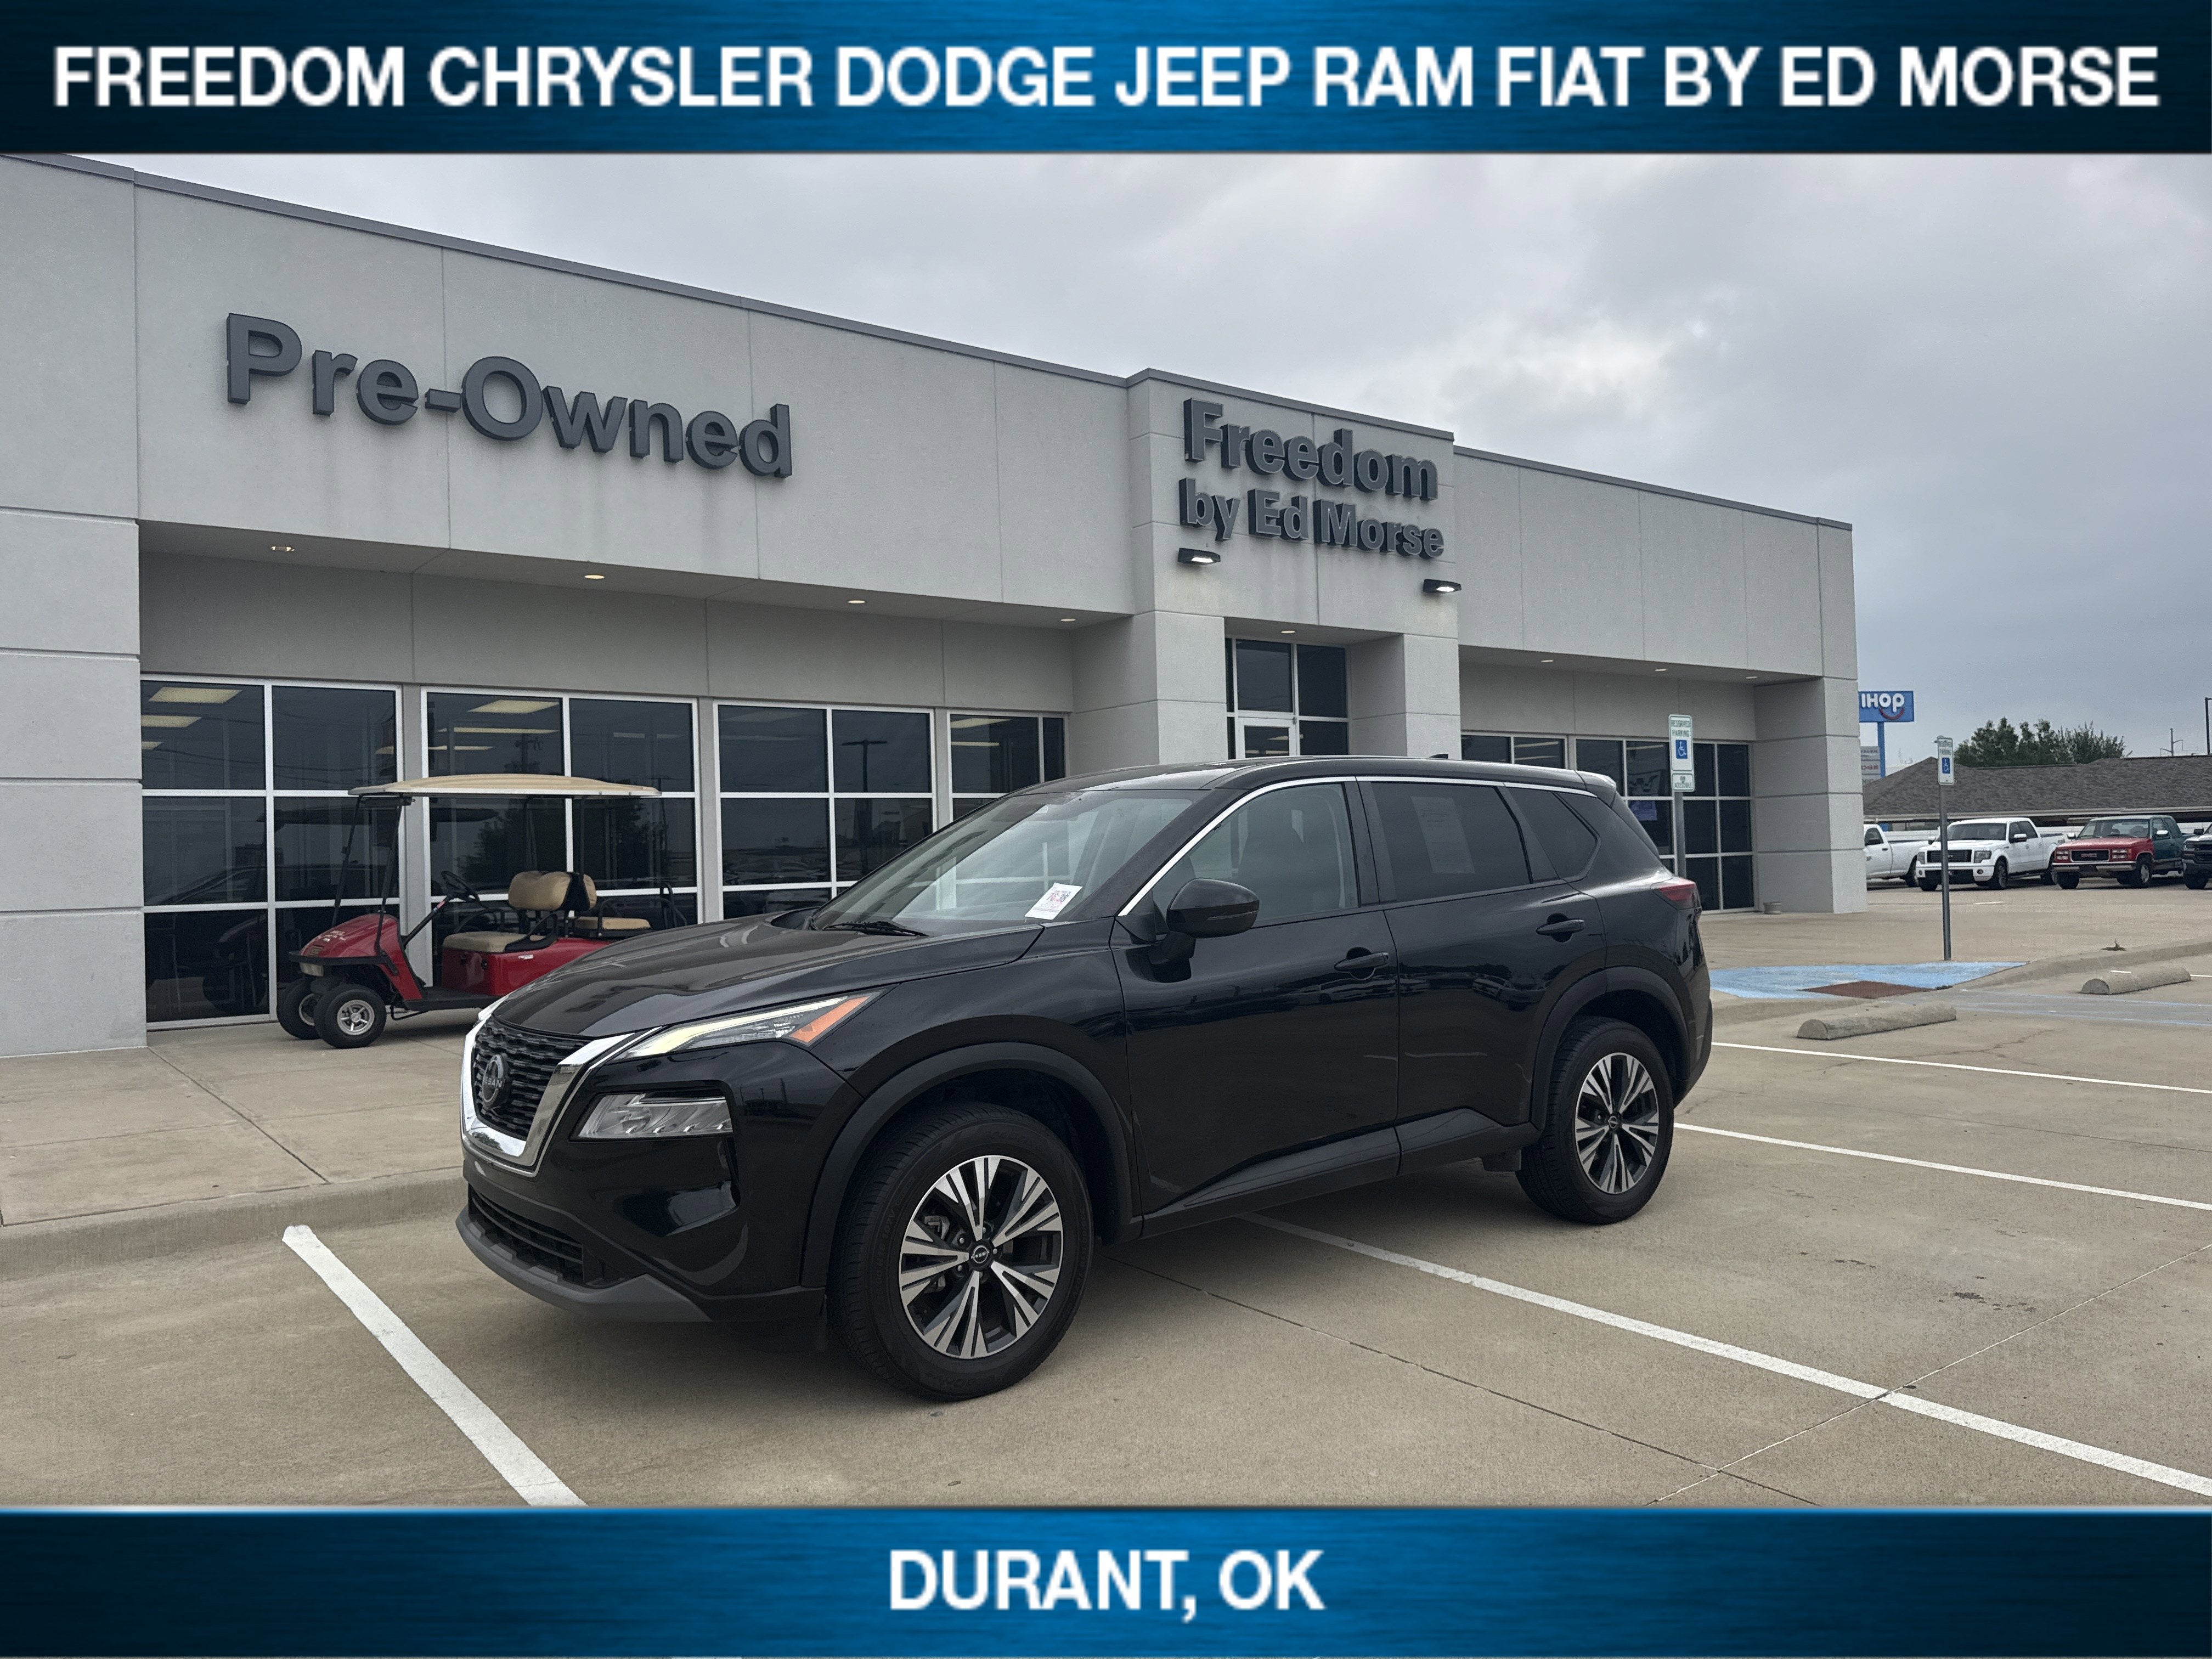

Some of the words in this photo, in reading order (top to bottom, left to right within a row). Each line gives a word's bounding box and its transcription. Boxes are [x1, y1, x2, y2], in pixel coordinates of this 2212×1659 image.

[226, 312, 793, 479] Pre-Owned
[1183, 398, 1438, 500] Freedom
[1179, 477, 1240, 542] by
[1248, 488, 1309, 541] Ed
[1313, 499, 1445, 558] Morse
